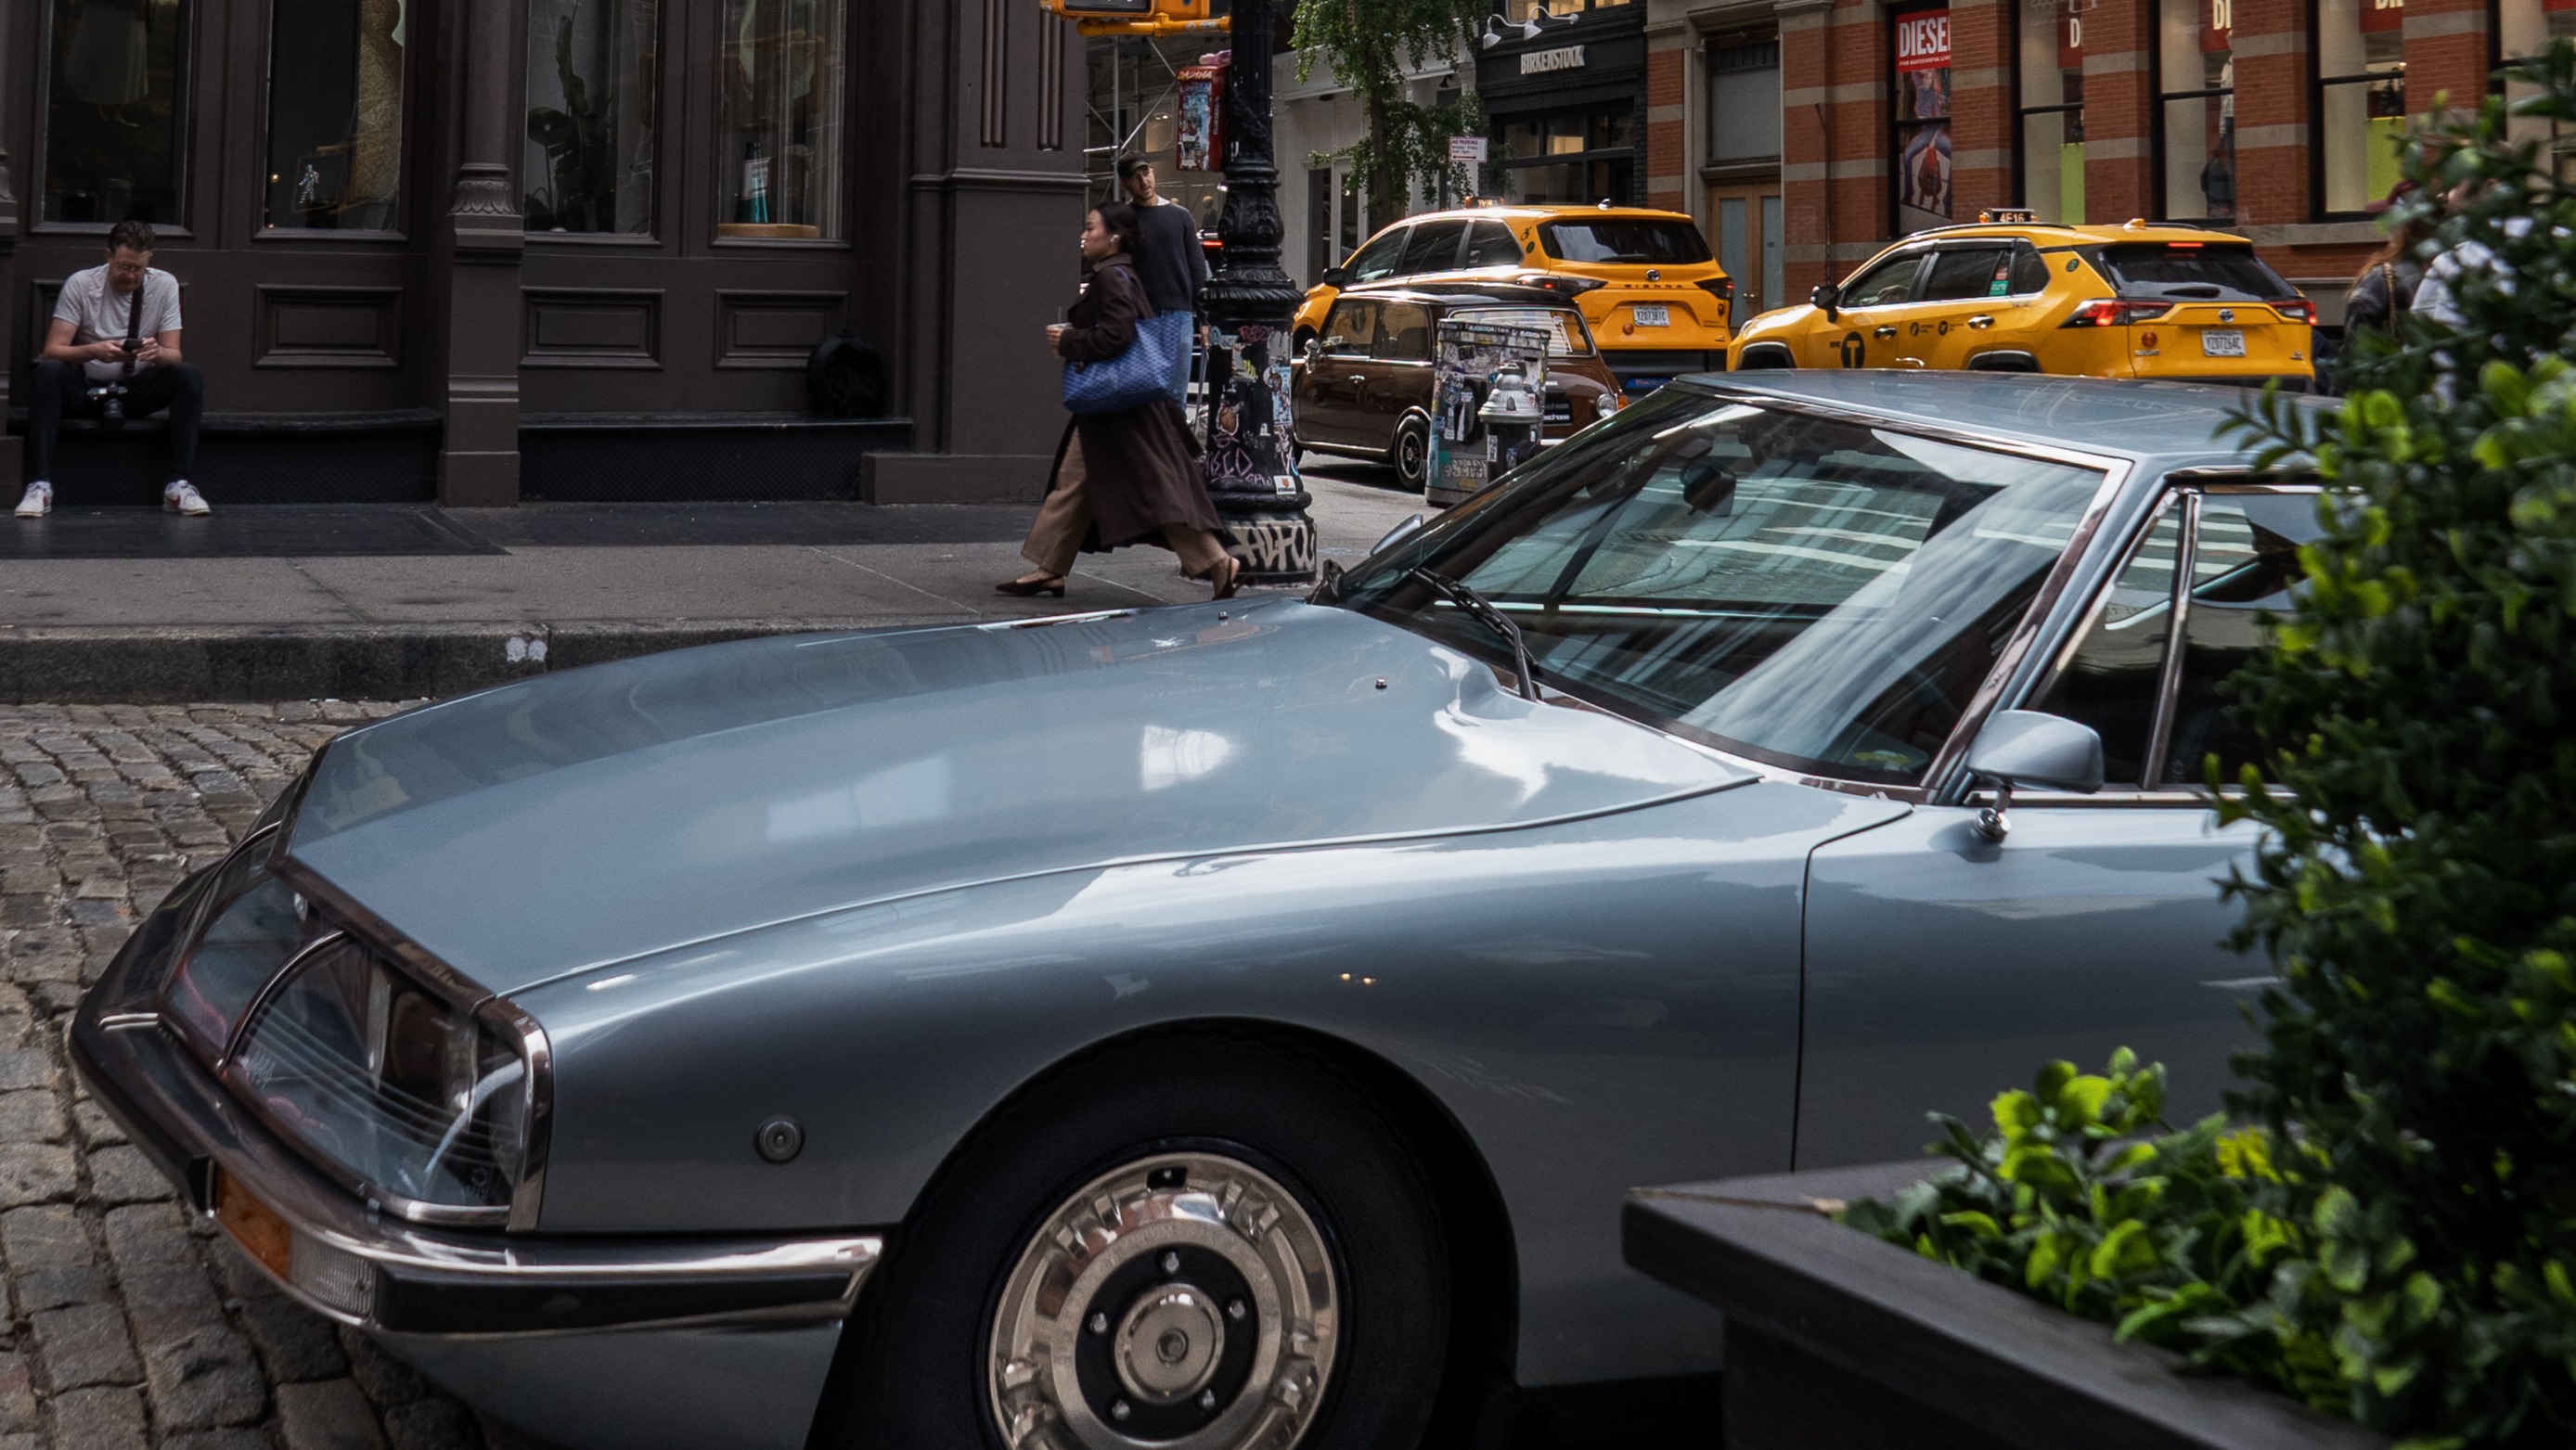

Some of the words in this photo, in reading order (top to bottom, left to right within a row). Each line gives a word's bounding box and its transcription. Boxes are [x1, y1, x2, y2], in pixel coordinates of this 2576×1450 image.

[1899, 17, 1951, 58] DIESE
[2069, 18, 2081, 48] D
[1520, 45, 1585, 75] BIRKENSTOCK
[1846, 340, 1860, 369] T
